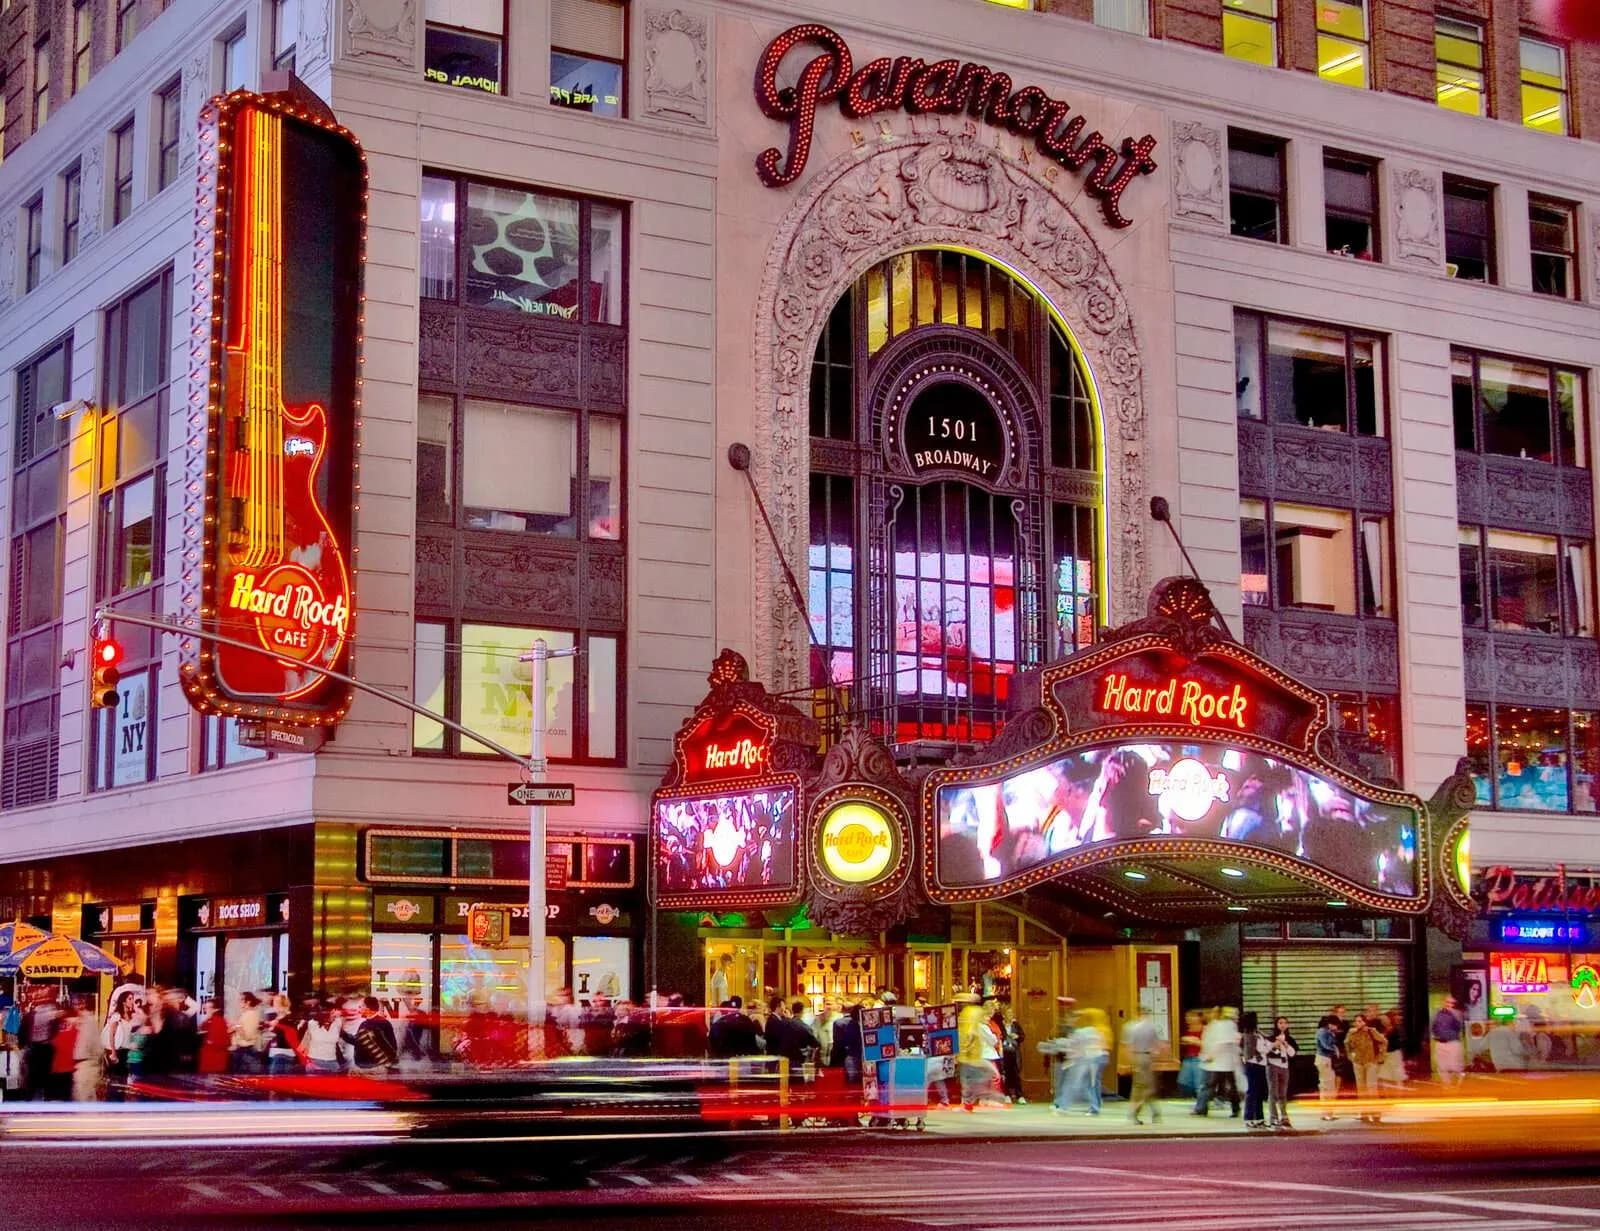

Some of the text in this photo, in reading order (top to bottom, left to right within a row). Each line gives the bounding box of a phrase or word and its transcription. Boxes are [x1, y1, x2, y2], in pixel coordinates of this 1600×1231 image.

[755, 23, 1157, 228] Paramount
[929, 416, 976, 441] 1501
[914, 449, 991, 474] BROADWAY
[230, 573, 348, 638] Hard Rock
[274, 628, 307, 648] CAFE
[123, 690, 130, 718] I
[1103, 674, 1248, 728] Hard Rock
[122, 721, 146, 754] NY
[705, 739, 764, 769] Hard Roc
[517, 787, 567, 799] ONE WAY
[825, 830, 888, 848] Hard Rock
[219, 903, 260, 919] ROCK SHOP
[25, 964, 79, 975] SABRETT
[1501, 958, 1548, 984] PIZZA
[579, 974, 590, 993] I
